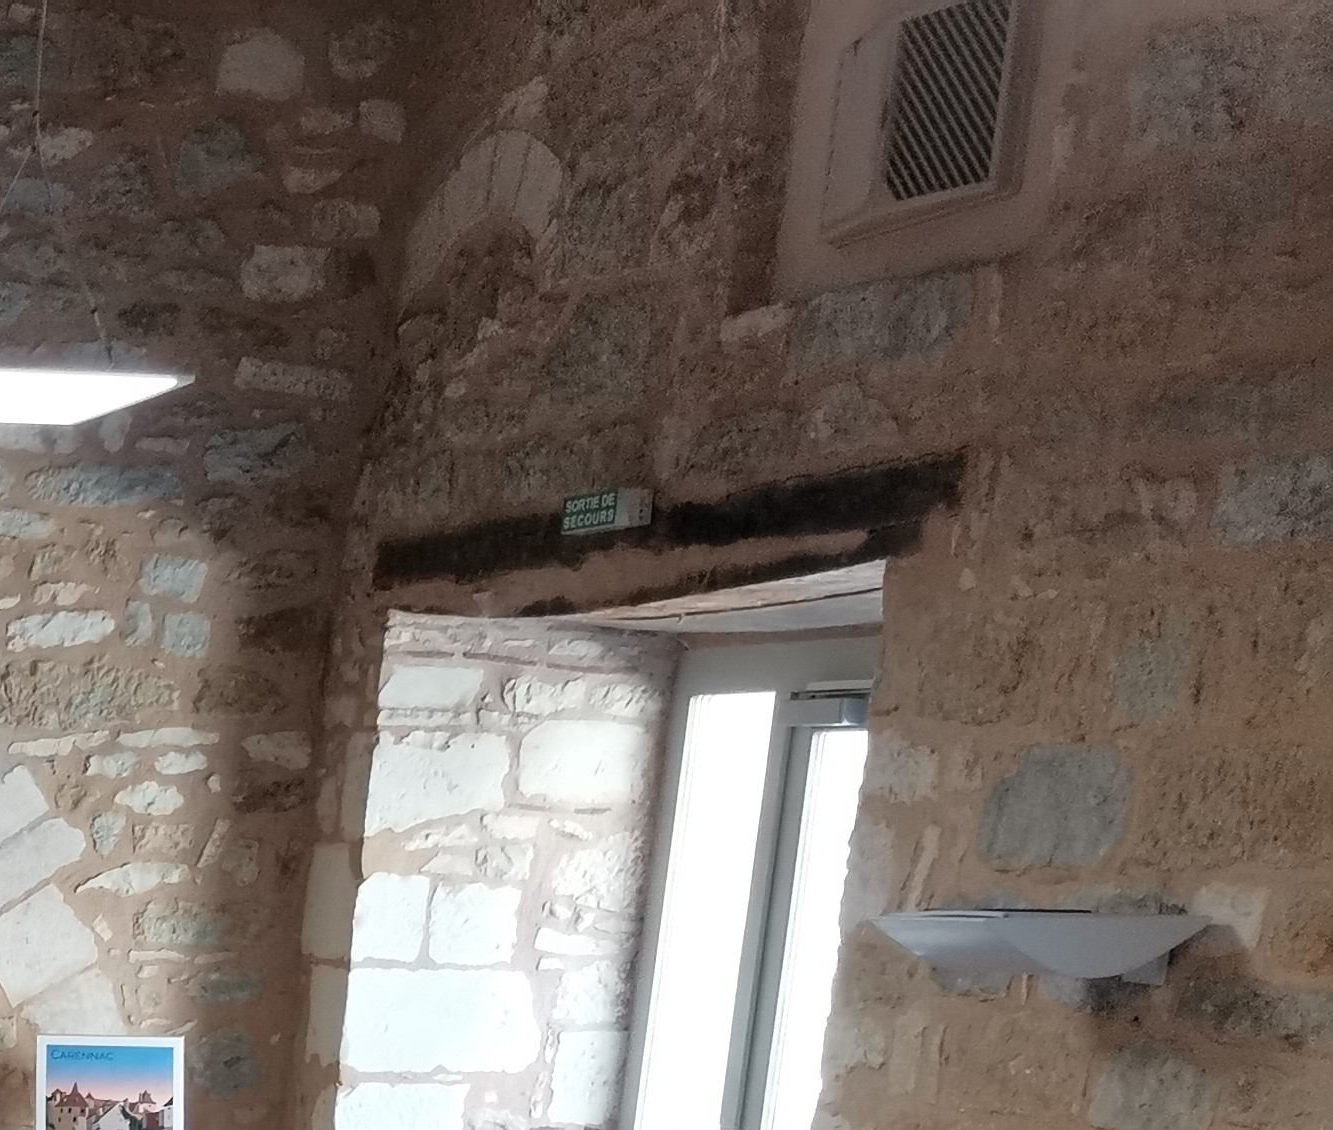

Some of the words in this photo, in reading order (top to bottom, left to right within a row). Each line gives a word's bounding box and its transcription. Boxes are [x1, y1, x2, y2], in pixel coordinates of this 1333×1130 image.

[565, 495, 600, 513] SORTIE
[601, 493, 617, 506] DE
[563, 508, 614, 530] SECOURS
[50, 1048, 115, 1062] CARENNAC
